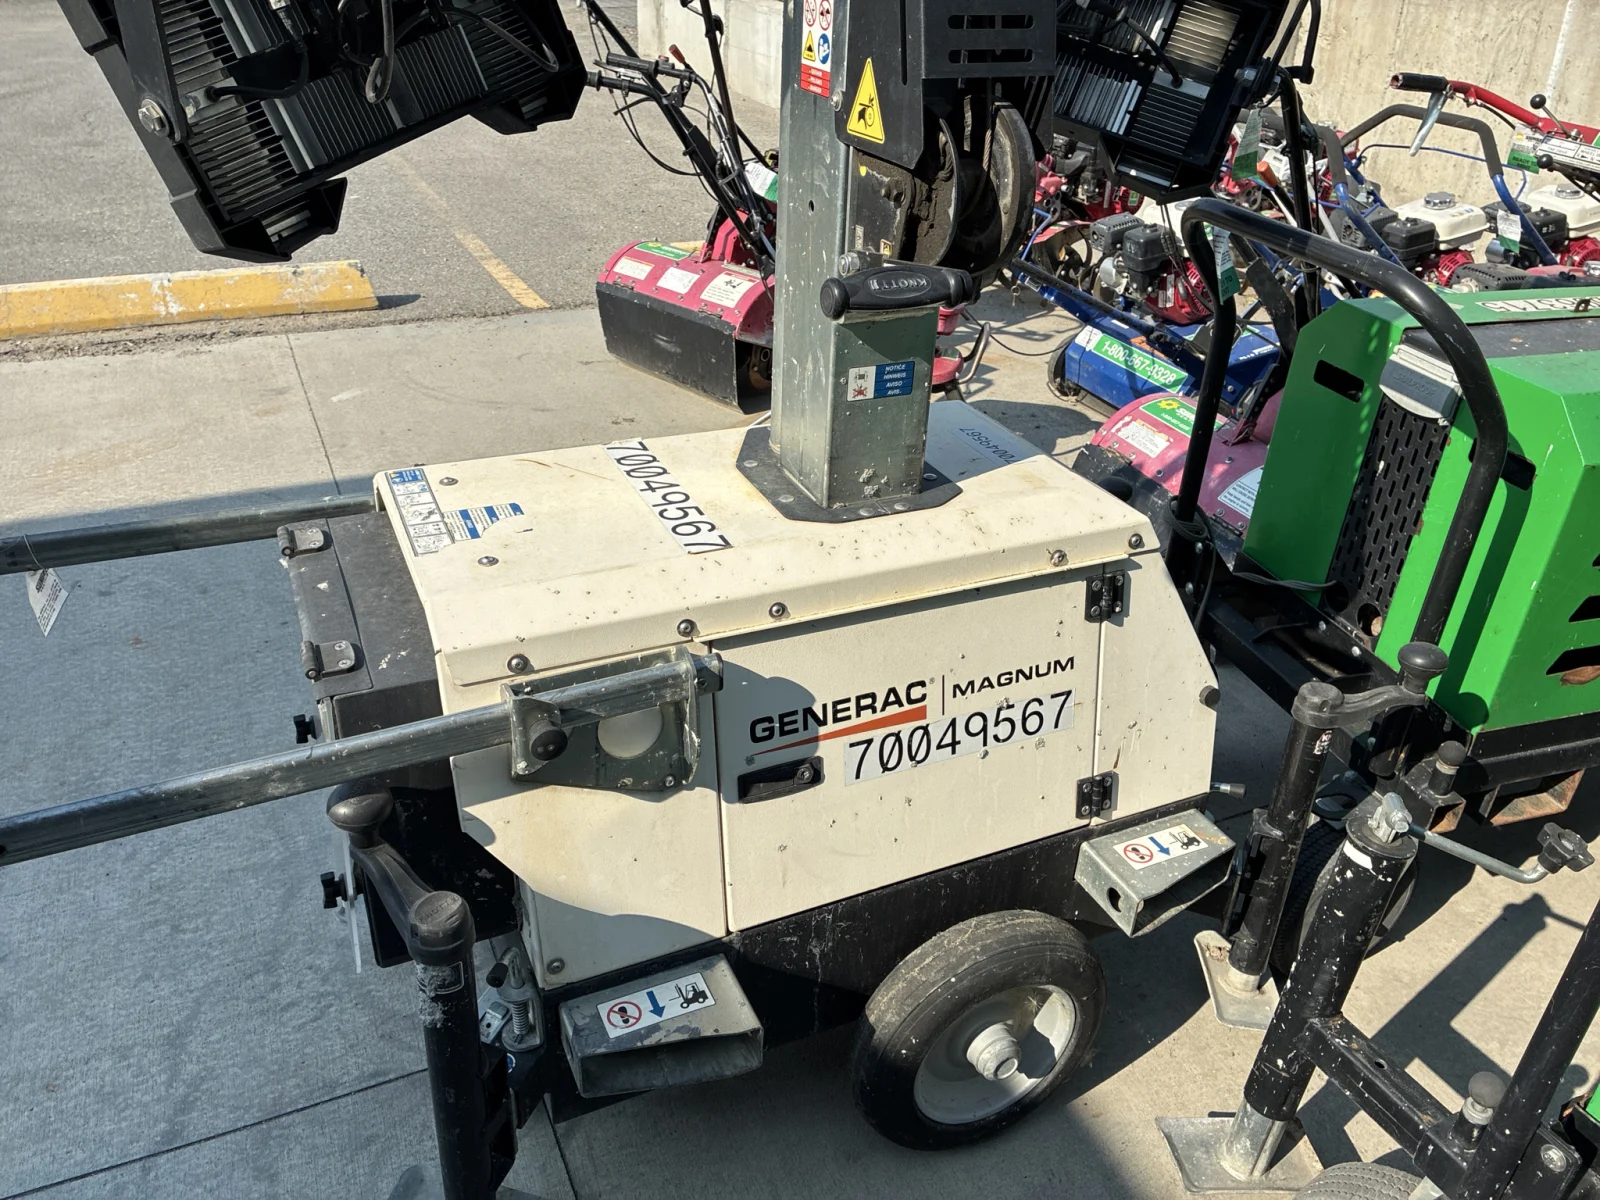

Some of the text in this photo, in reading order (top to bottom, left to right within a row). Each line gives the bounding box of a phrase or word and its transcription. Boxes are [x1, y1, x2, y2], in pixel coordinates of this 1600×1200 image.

[883, 372, 907, 381] HINWEIS
[885, 364, 906, 372] NOTICE
[886, 380, 903, 388] AVISO
[1102, 340, 1177, 385] 1-800-667-9328
[606, 440, 732, 547] 70049567
[750, 656, 1075, 744] GENERAC MAGNUM
[848, 689, 1074, 781] 70049567
